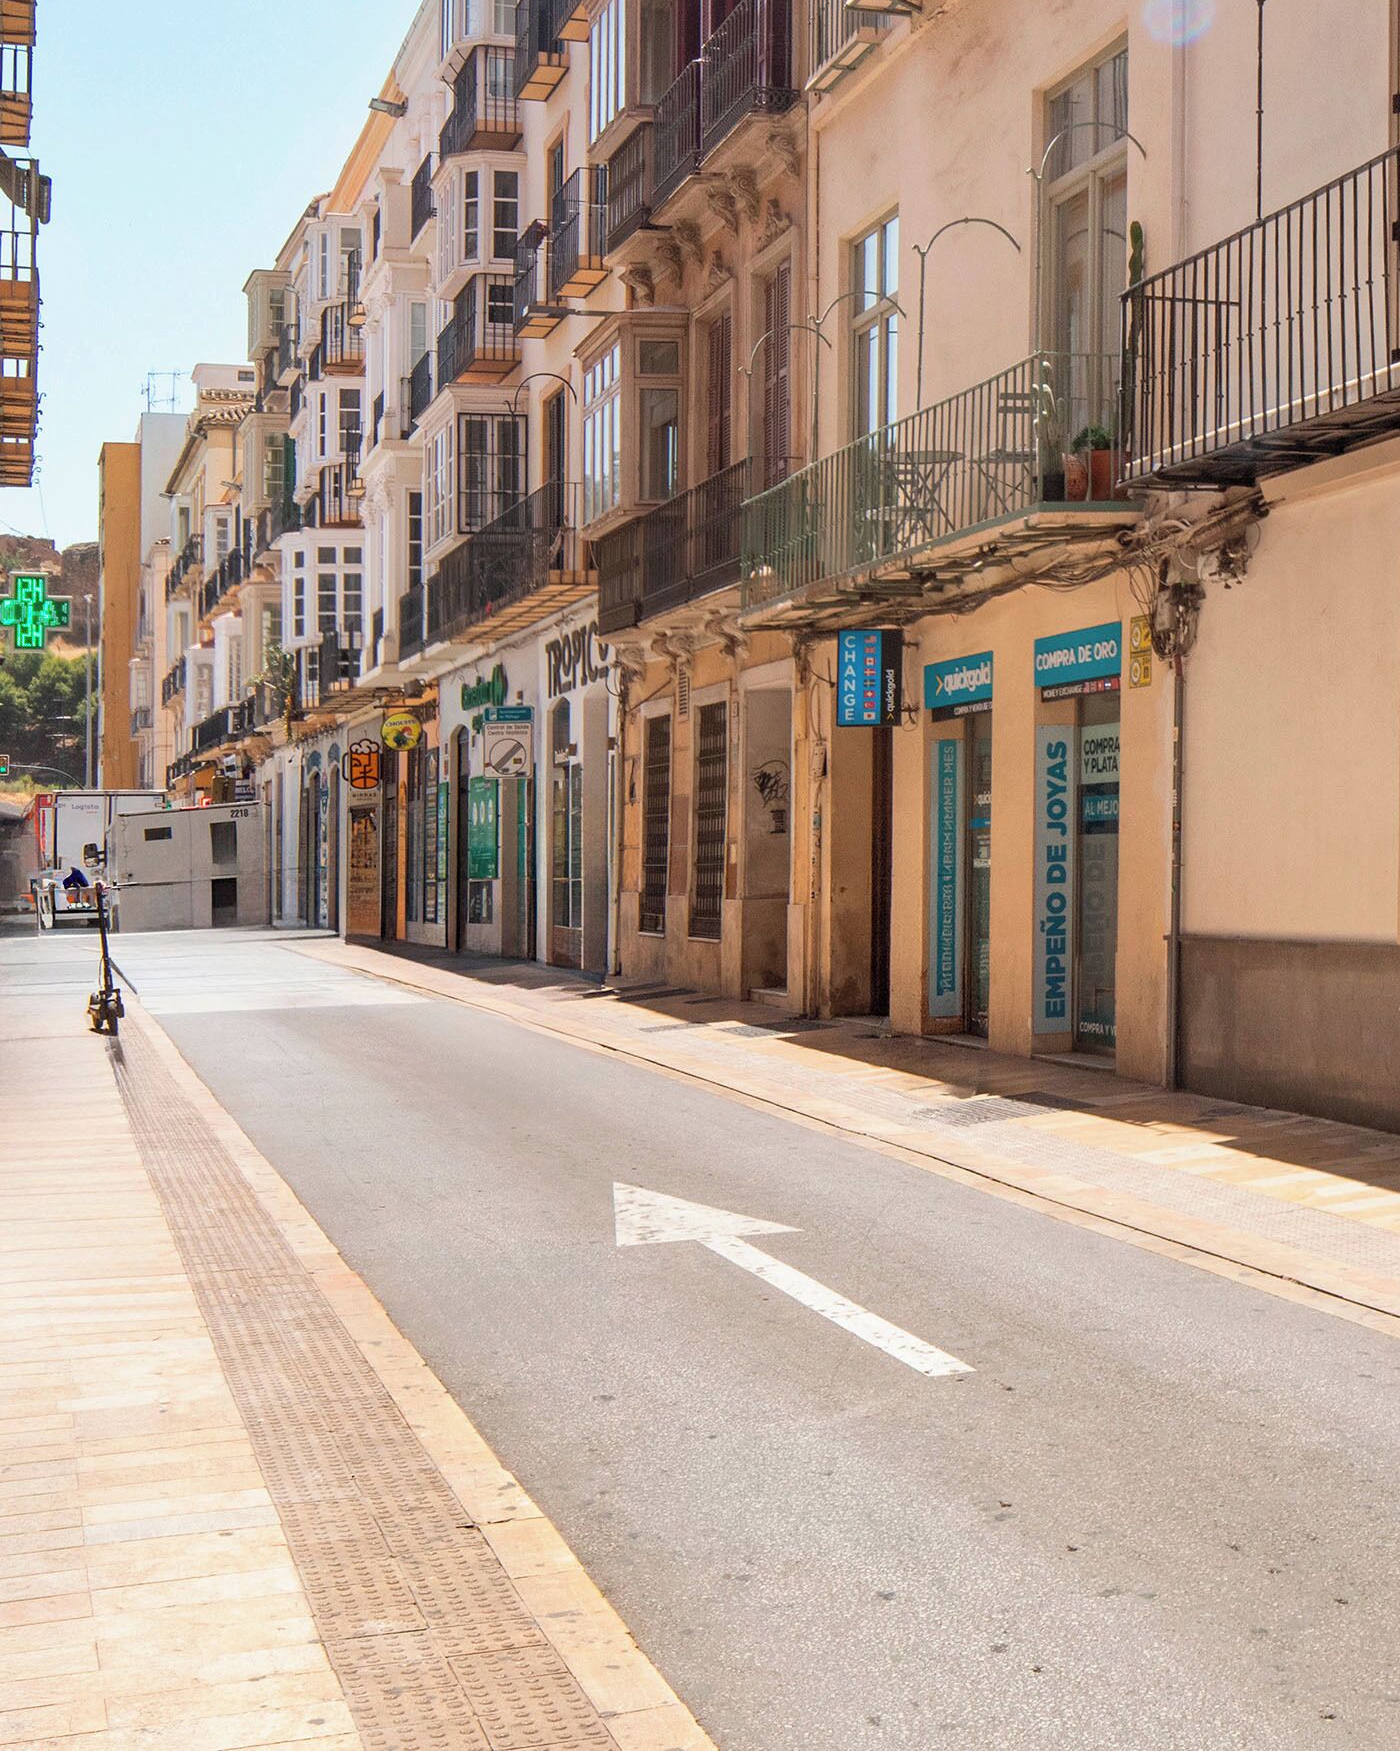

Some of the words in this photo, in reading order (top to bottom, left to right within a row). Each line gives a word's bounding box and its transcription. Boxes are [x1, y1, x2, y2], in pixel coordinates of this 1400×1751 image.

[1036, 648, 1076, 671] COMPRA
[1078, 645, 1092, 663] DE
[1094, 640, 1117, 660] ORO
[844, 636, 856, 721] CHANGE
[886, 669, 896, 712] quickgold
[944, 661, 990, 696] quickgold
[1084, 736, 1120, 756] COMPRA
[1084, 758, 1089, 774] Y
[1091, 756, 1118, 773] PLATA
[1046, 741, 1067, 836] JOYAS
[230, 809, 249, 818] 2218
[1046, 845, 1067, 884] DE
[1040, 893, 1067, 1018] EMPEÑO
[1080, 1021, 1104, 1035] COMPRA
